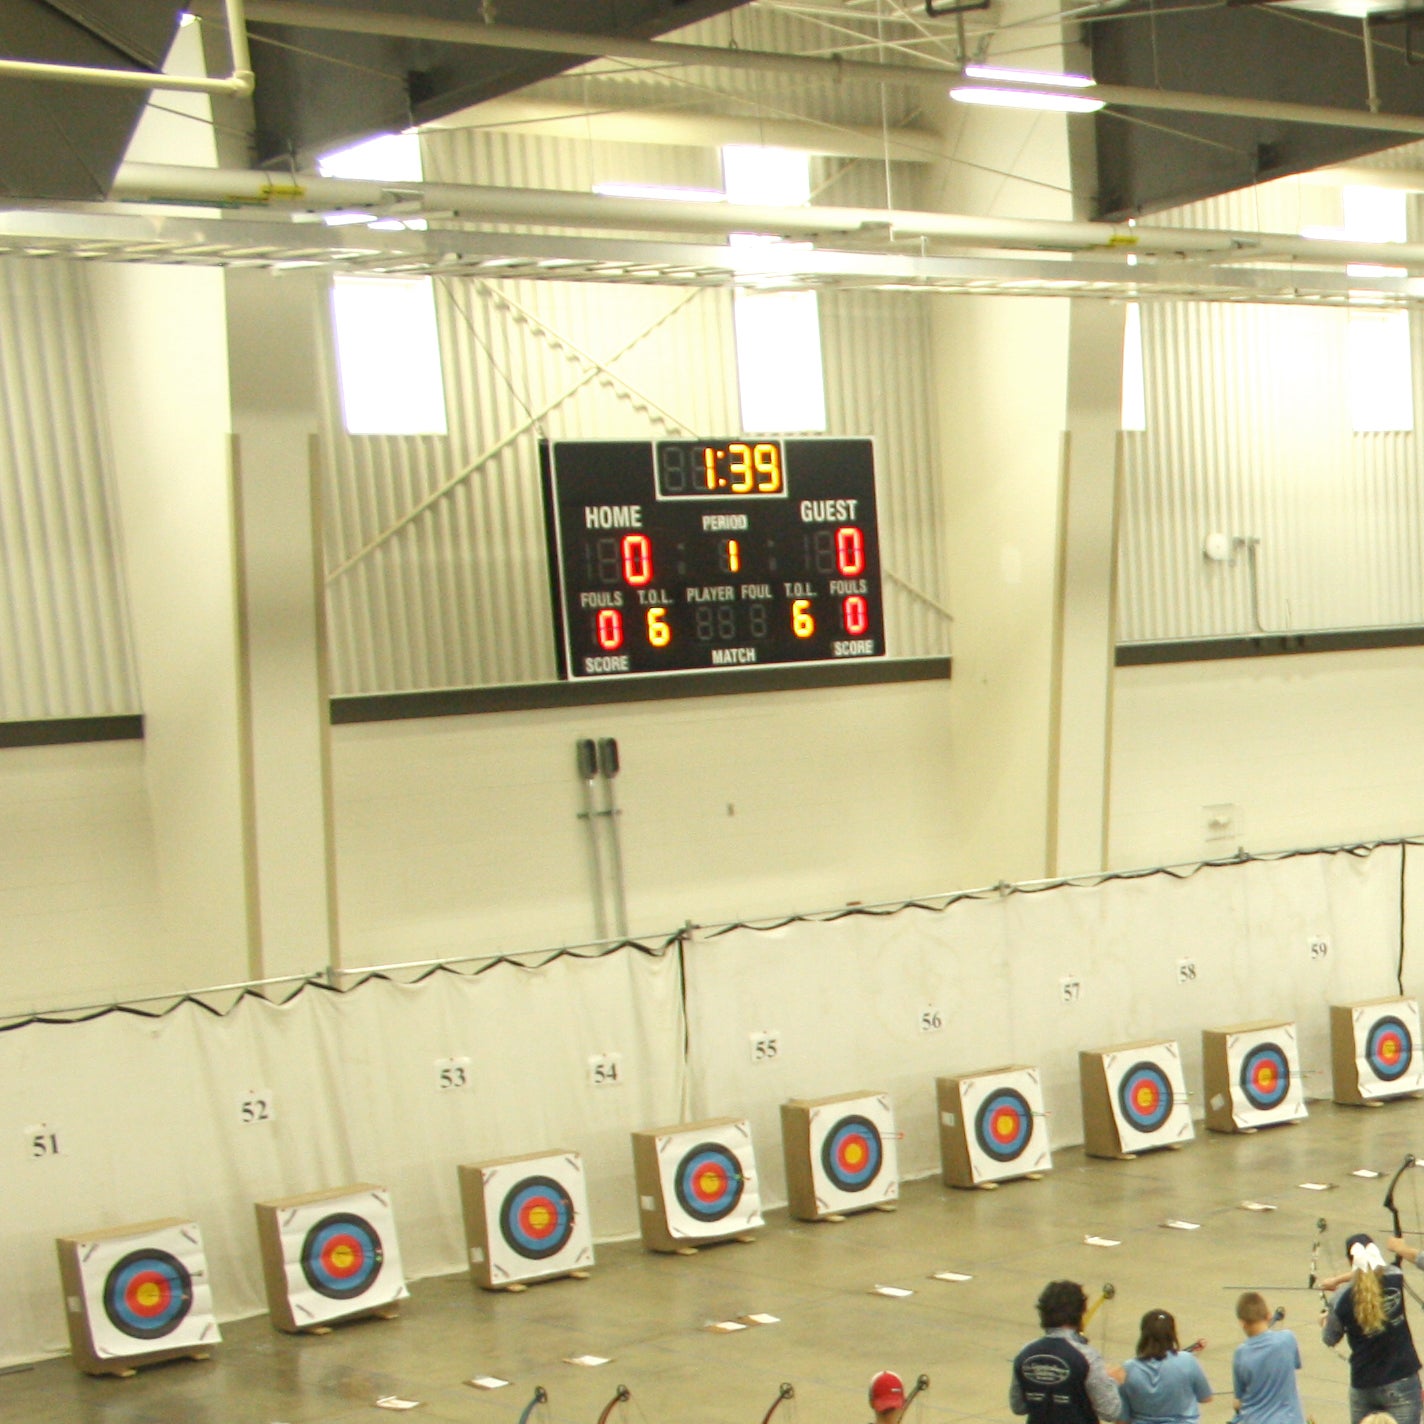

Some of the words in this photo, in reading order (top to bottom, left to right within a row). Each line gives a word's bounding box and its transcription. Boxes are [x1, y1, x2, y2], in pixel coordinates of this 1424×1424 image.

[704, 443, 781, 493] 1:39
[585, 505, 643, 529] HOME
[800, 500, 857, 523] GUEST
[702, 514, 748, 531] PERIOD
[620, 533, 653, 586] 0
[727, 539, 740, 573] 1
[835, 526, 865, 577] 0
[637, 589, 674, 605] T.O.L.
[687, 585, 735, 602] PLAYER
[740, 584, 771, 599] FOUL
[784, 581, 817, 597] T.O.L.
[830, 579, 867, 595] FOULS
[581, 590, 623, 608] FOULS
[791, 599, 815, 639] 6
[842, 595, 869, 635] 0
[597, 609, 623, 650] 0
[646, 606, 671, 648] 6
[712, 648, 755, 665] MATCH
[834, 640, 874, 656] SCORE
[585, 656, 629, 672] SCORE
[1310, 942, 1328, 960] 59
[1179, 963, 1197, 983] 58
[1063, 982, 1081, 1002] 57
[921, 1010, 942, 1031] 56
[755, 1039, 778, 1060] 55
[439, 1067, 467, 1089] 53
[594, 1062, 619, 1084] 54
[241, 1099, 269, 1123] 52
[32, 1133, 59, 1157] 51
